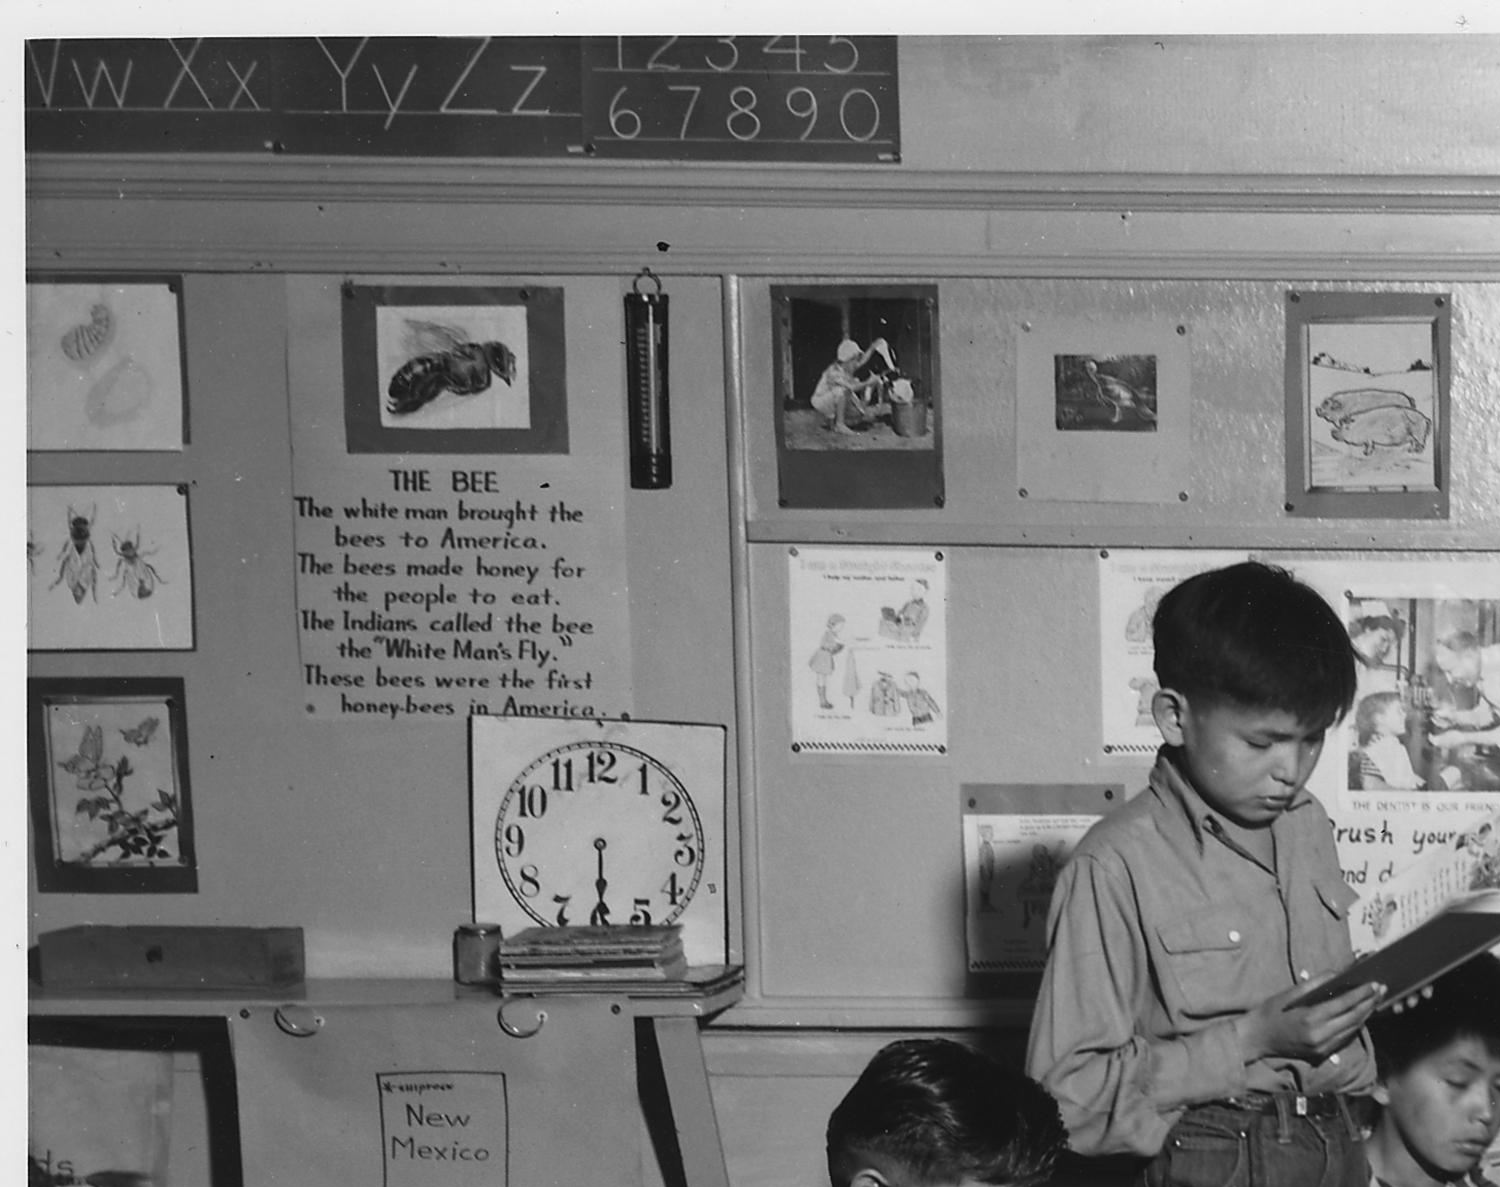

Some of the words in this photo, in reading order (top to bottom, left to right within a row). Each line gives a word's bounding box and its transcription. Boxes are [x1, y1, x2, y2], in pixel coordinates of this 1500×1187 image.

[609, 86, 641, 140] 6
[668, 86, 701, 140] 7
[726, 86, 761, 140] 8
[786, 87, 817, 141] 9
[840, 88, 880, 142] 0
[389, 469, 431, 493] THE
[452, 470, 500, 493] BEE
[294, 496, 333, 519] The
[344, 497, 398, 520] white
[405, 504, 449, 521] man
[458, 499, 539, 530] brought
[549, 501, 584, 523] the
[335, 525, 386, 548] bees
[400, 531, 429, 549] to
[440, 527, 547, 550] America.
[297, 552, 333, 576] The
[344, 553, 396, 576] bees
[406, 555, 463, 577] made
[476, 555, 539, 585] honey
[552, 557, 586, 579] for
[333, 581, 369, 602] the
[384, 583, 458, 612] people
[469, 588, 497, 606] to
[511, 588, 560, 607] eat.
[301, 609, 335, 631] The
[342, 610, 418, 633] Indians
[429, 612, 493, 633] called
[504, 612, 542, 634] the
[551, 613, 594, 635] bee
[337, 636, 372, 659] the
[453, 639, 512, 662] Man's
[304, 664, 365, 687] These
[376, 666, 425, 688] bees
[435, 674, 490, 689] were
[499, 668, 535, 689] the
[547, 668, 593, 690] first
[469, 698, 489, 716] in
[502, 695, 606, 718] America.
[551, 757, 574, 792] 11
[586, 750, 618, 784] 12
[638, 763, 650, 796] 1
[517, 784, 548, 819] 10
[661, 790, 682, 825] 2
[504, 823, 525, 857] 9
[674, 832, 695, 867] 3
[1328, 818, 1393, 845] rush
[1413, 829, 1456, 855] your
[519, 864, 540, 898] 8
[661, 872, 684, 905] 4
[553, 894, 572, 926] 7
[630, 898, 651, 926] 5
[406, 1103, 470, 1127] New
[392, 1136, 489, 1161] Mexico
